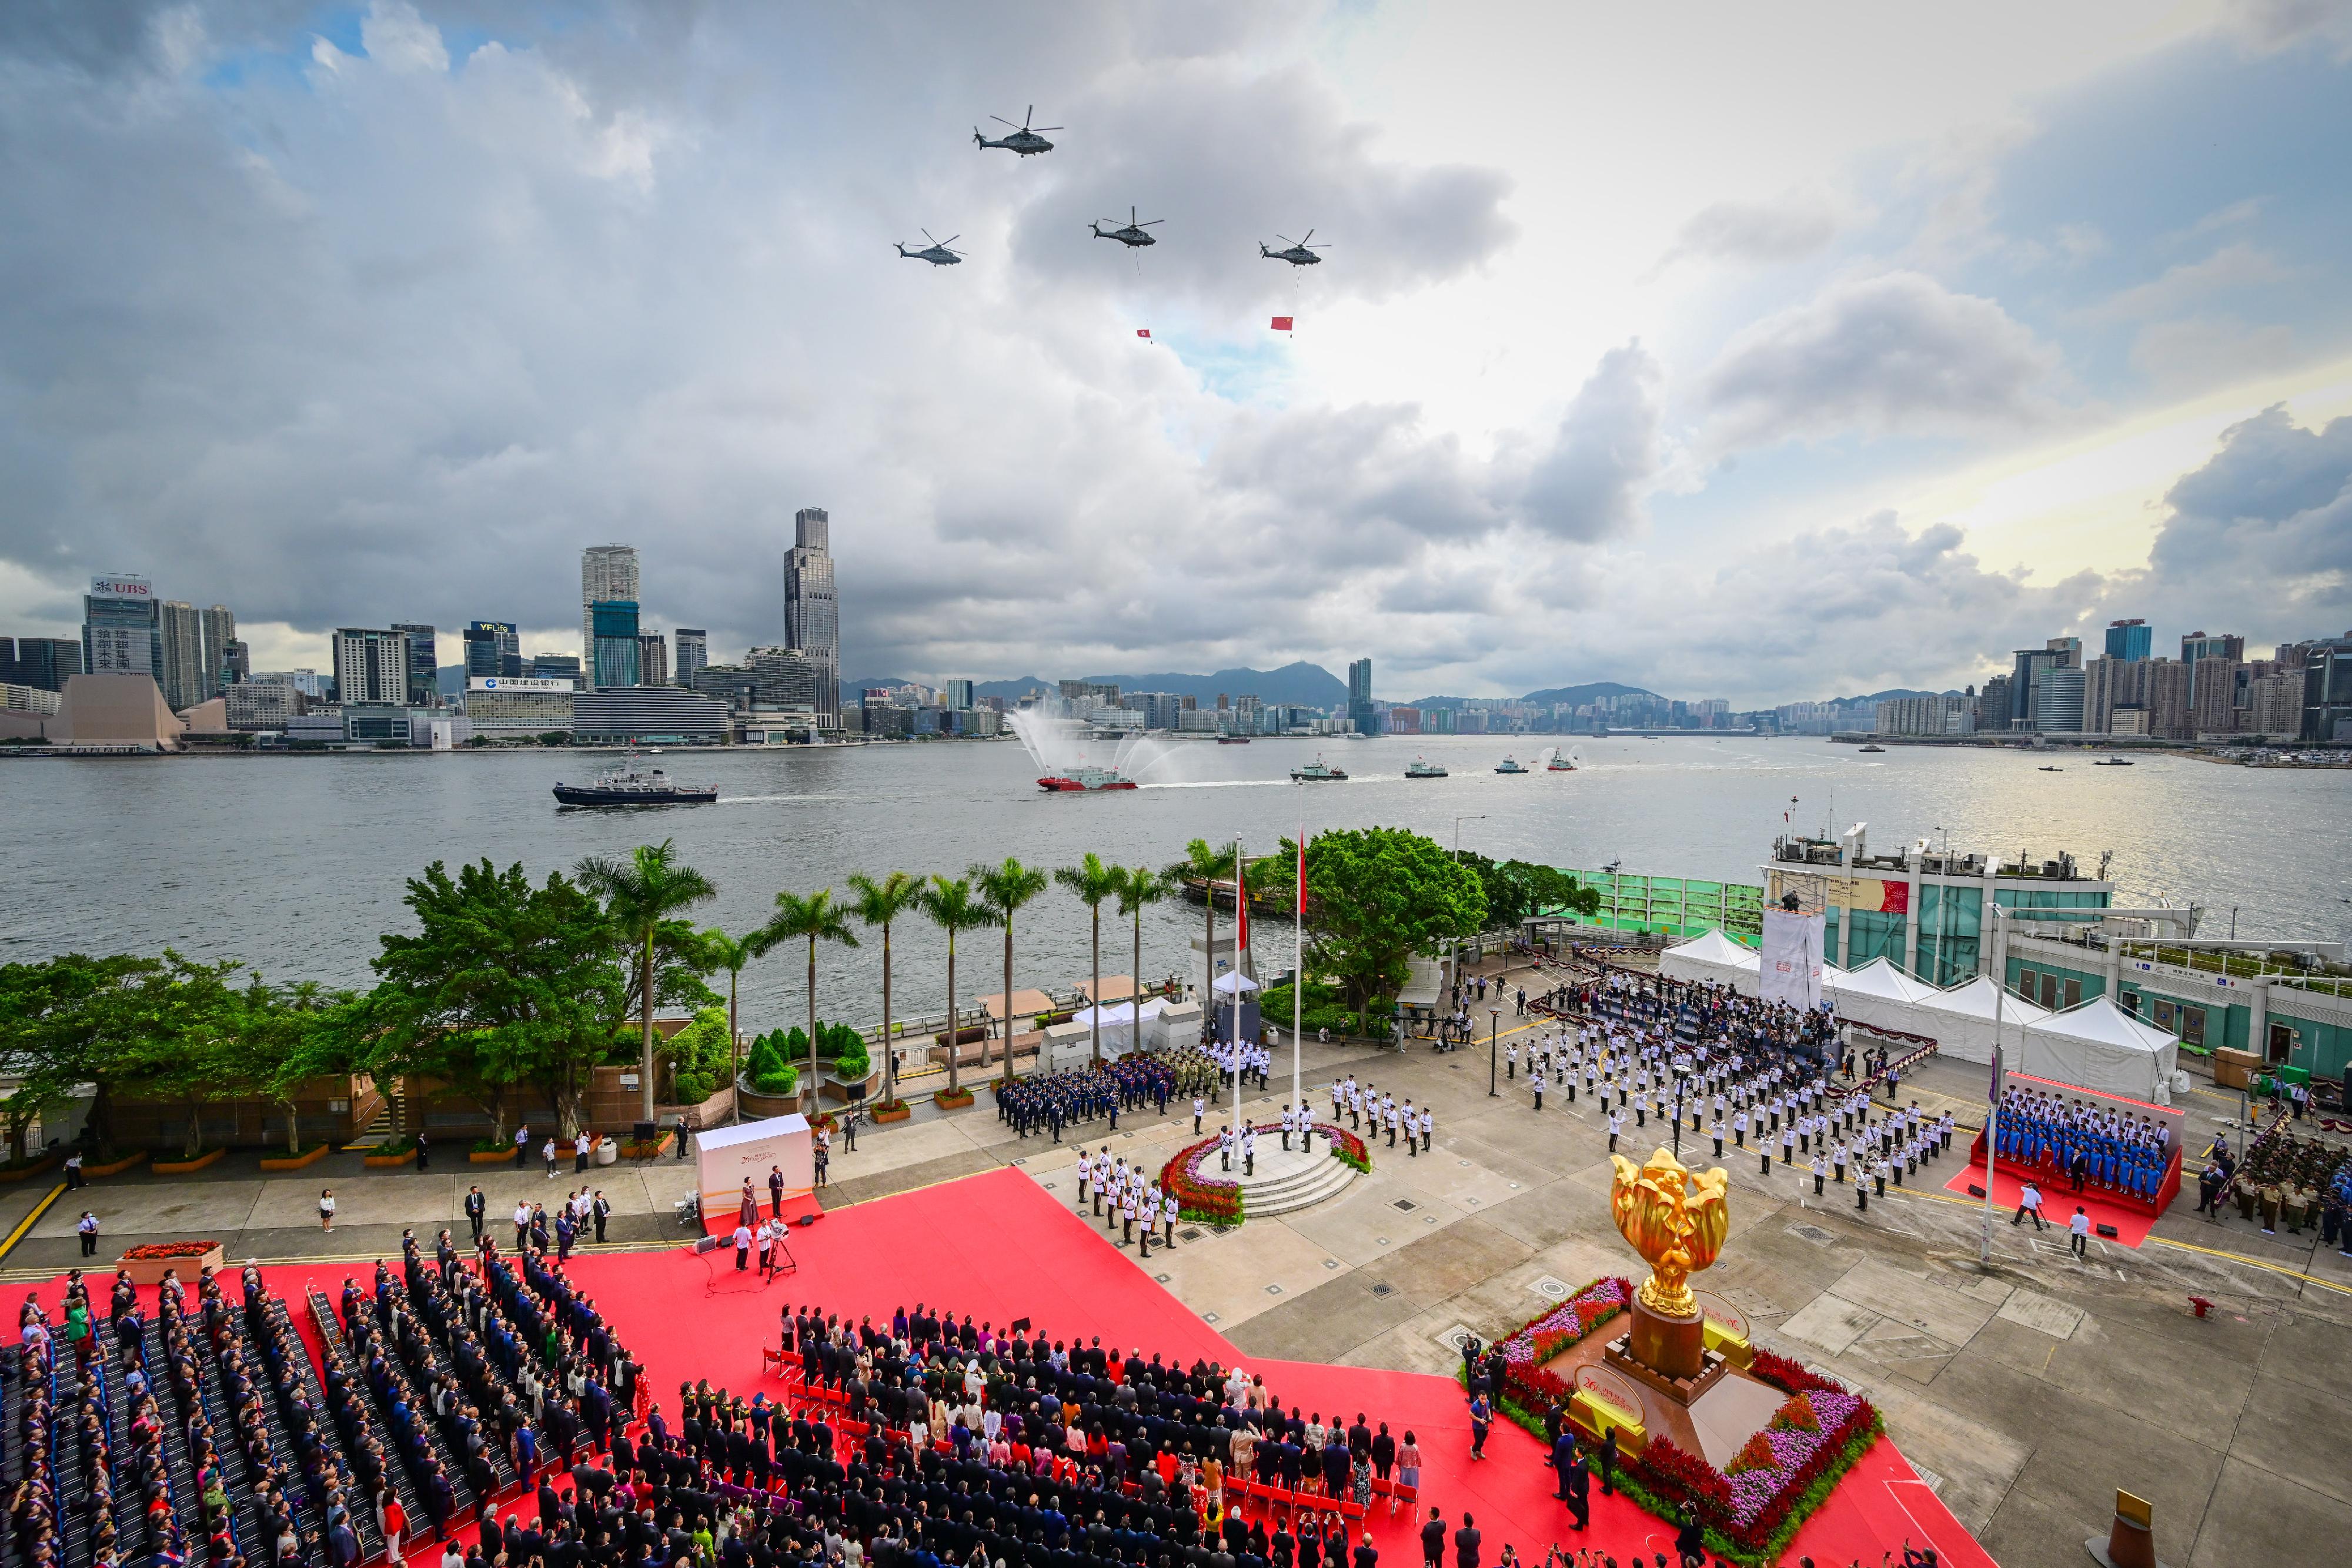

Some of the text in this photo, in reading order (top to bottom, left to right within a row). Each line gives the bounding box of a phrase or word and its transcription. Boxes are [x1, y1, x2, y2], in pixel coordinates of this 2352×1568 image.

[114, 583, 147, 594] UBS
[480, 623, 508, 633] YFLife
[96, 628, 112, 669] 領創未來
[115, 630, 130, 670] 瑞銀集團
[499, 678, 560, 687] 中国建设银行
[1598, 1390, 1632, 1414] ANNIVERSARY
